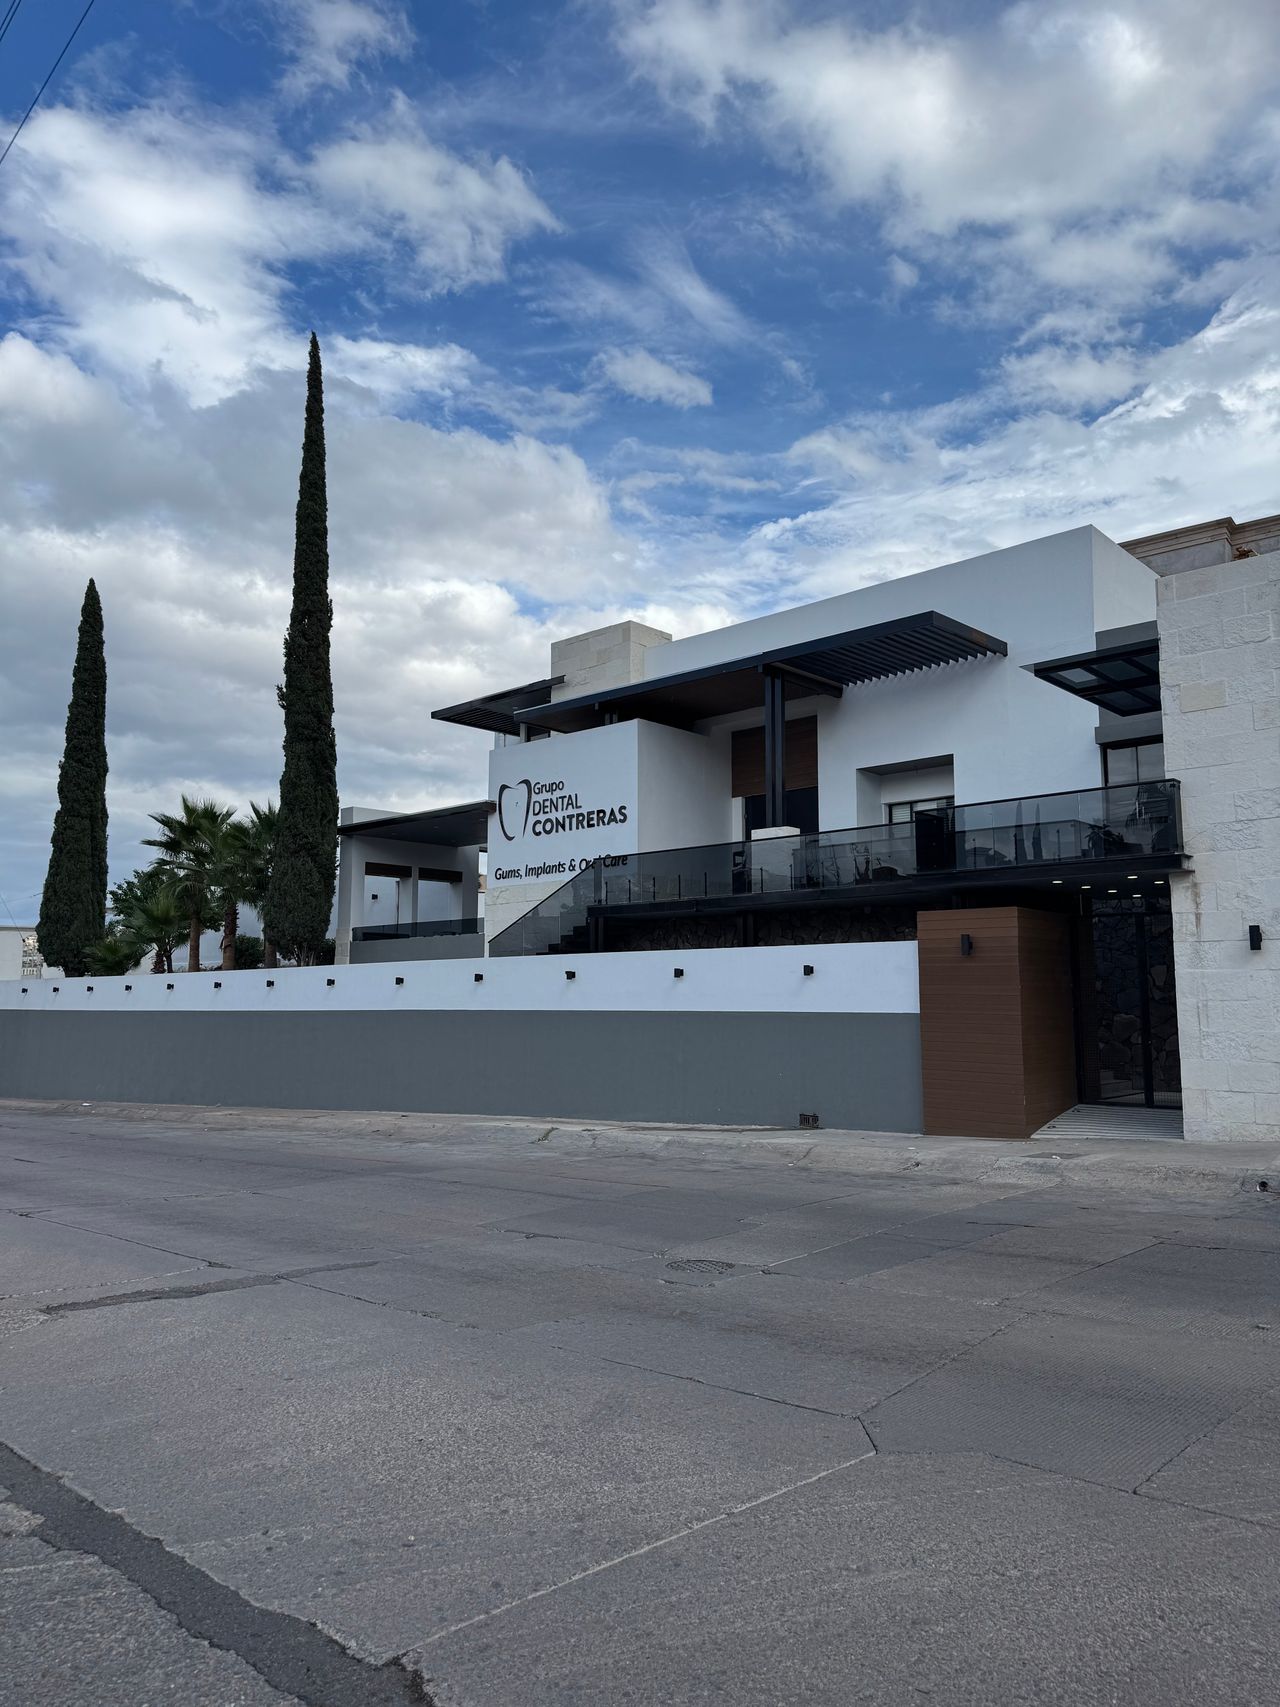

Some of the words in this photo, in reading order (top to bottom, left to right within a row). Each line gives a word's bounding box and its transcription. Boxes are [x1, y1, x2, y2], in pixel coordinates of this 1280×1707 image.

[533, 780, 565, 795] Grupo
[532, 793, 582, 816] DENTAL
[532, 805, 628, 837] CONTRERAS
[494, 867, 523, 880] Gums,
[525, 860, 566, 878] Implants
[568, 858, 576, 872] &
[579, 855, 601, 871] Or
[603, 854, 628, 868] Care
